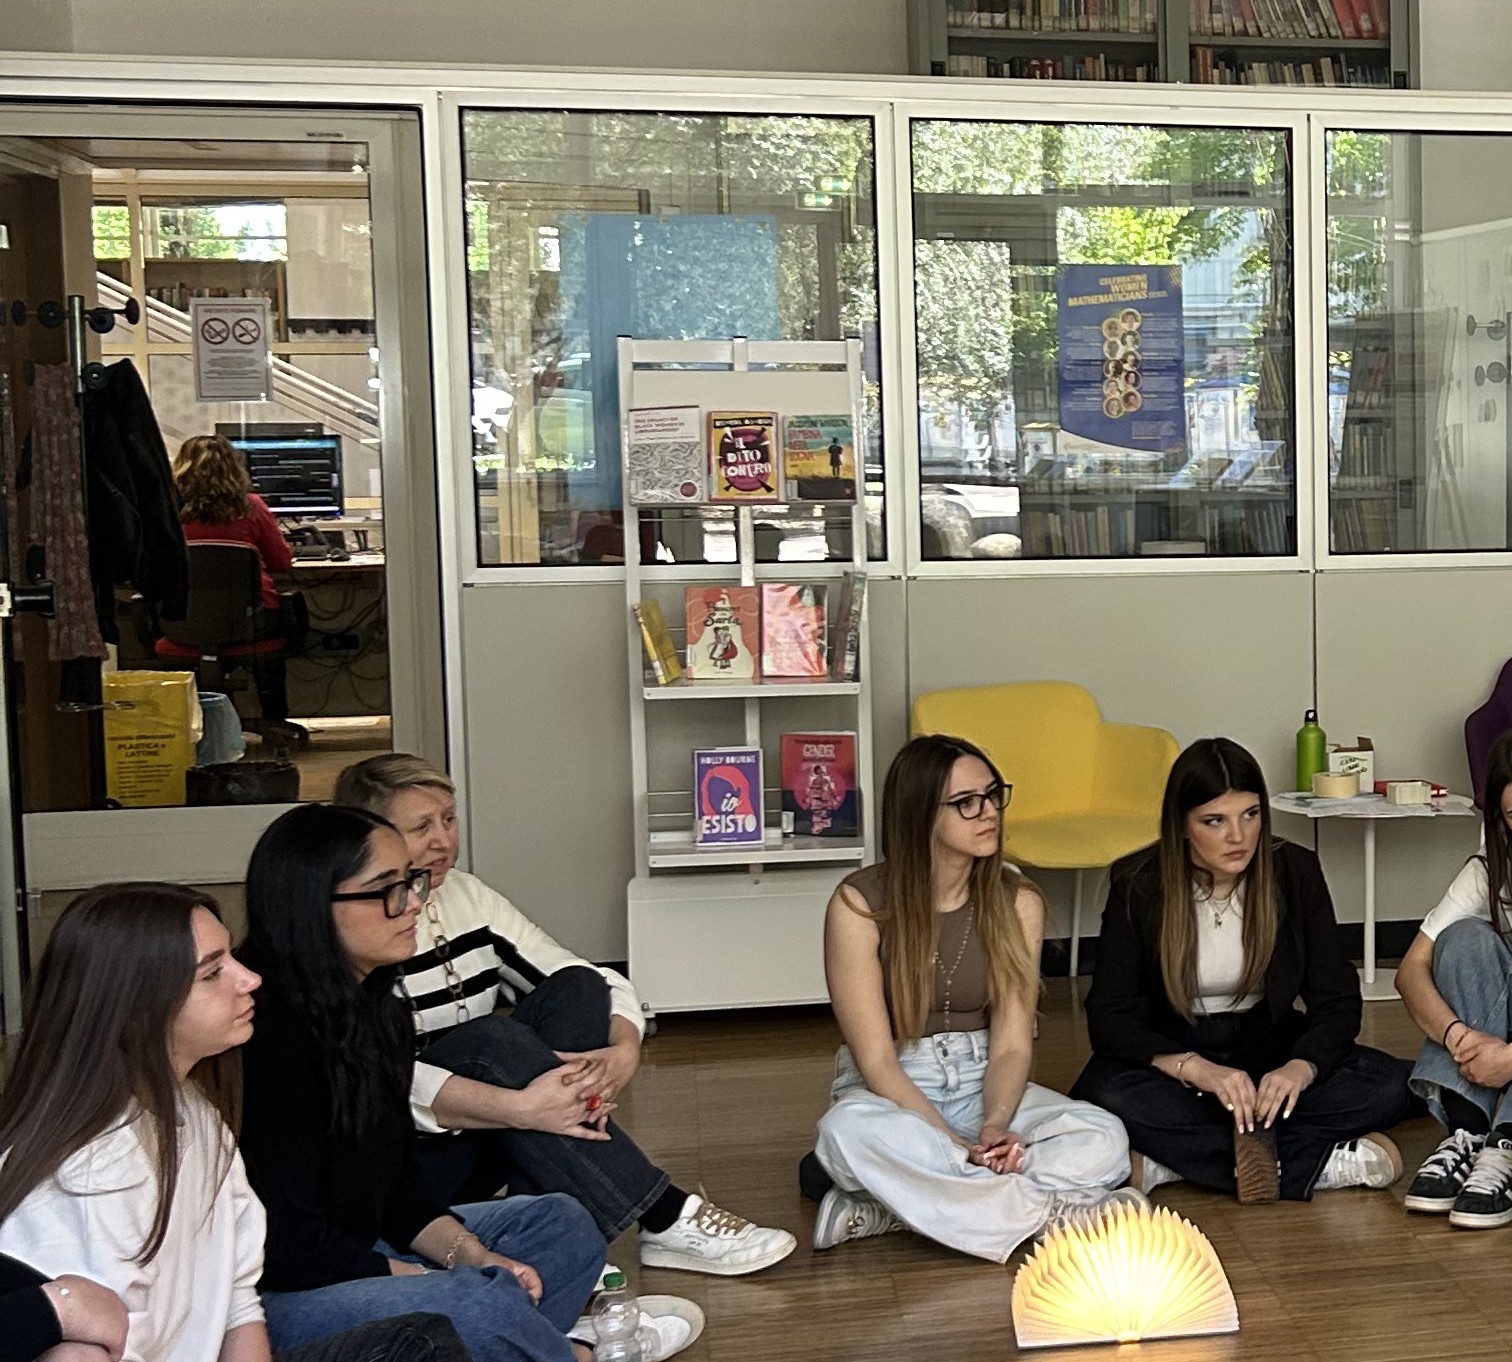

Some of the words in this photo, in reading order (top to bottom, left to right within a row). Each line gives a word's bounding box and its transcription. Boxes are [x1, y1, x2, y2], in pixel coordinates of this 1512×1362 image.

[1111, 282, 1148, 293] WOMEN
[1067, 290, 1148, 308] MATHEMATICIANS
[726, 449, 762, 463] DITO
[721, 462, 772, 478] CONTRO
[802, 744, 836, 758] GENDER
[700, 756, 725, 765] HOLLY
[725, 754, 757, 764] BOURNE
[720, 792, 742, 812] io
[701, 813, 758, 834] ESISTO
